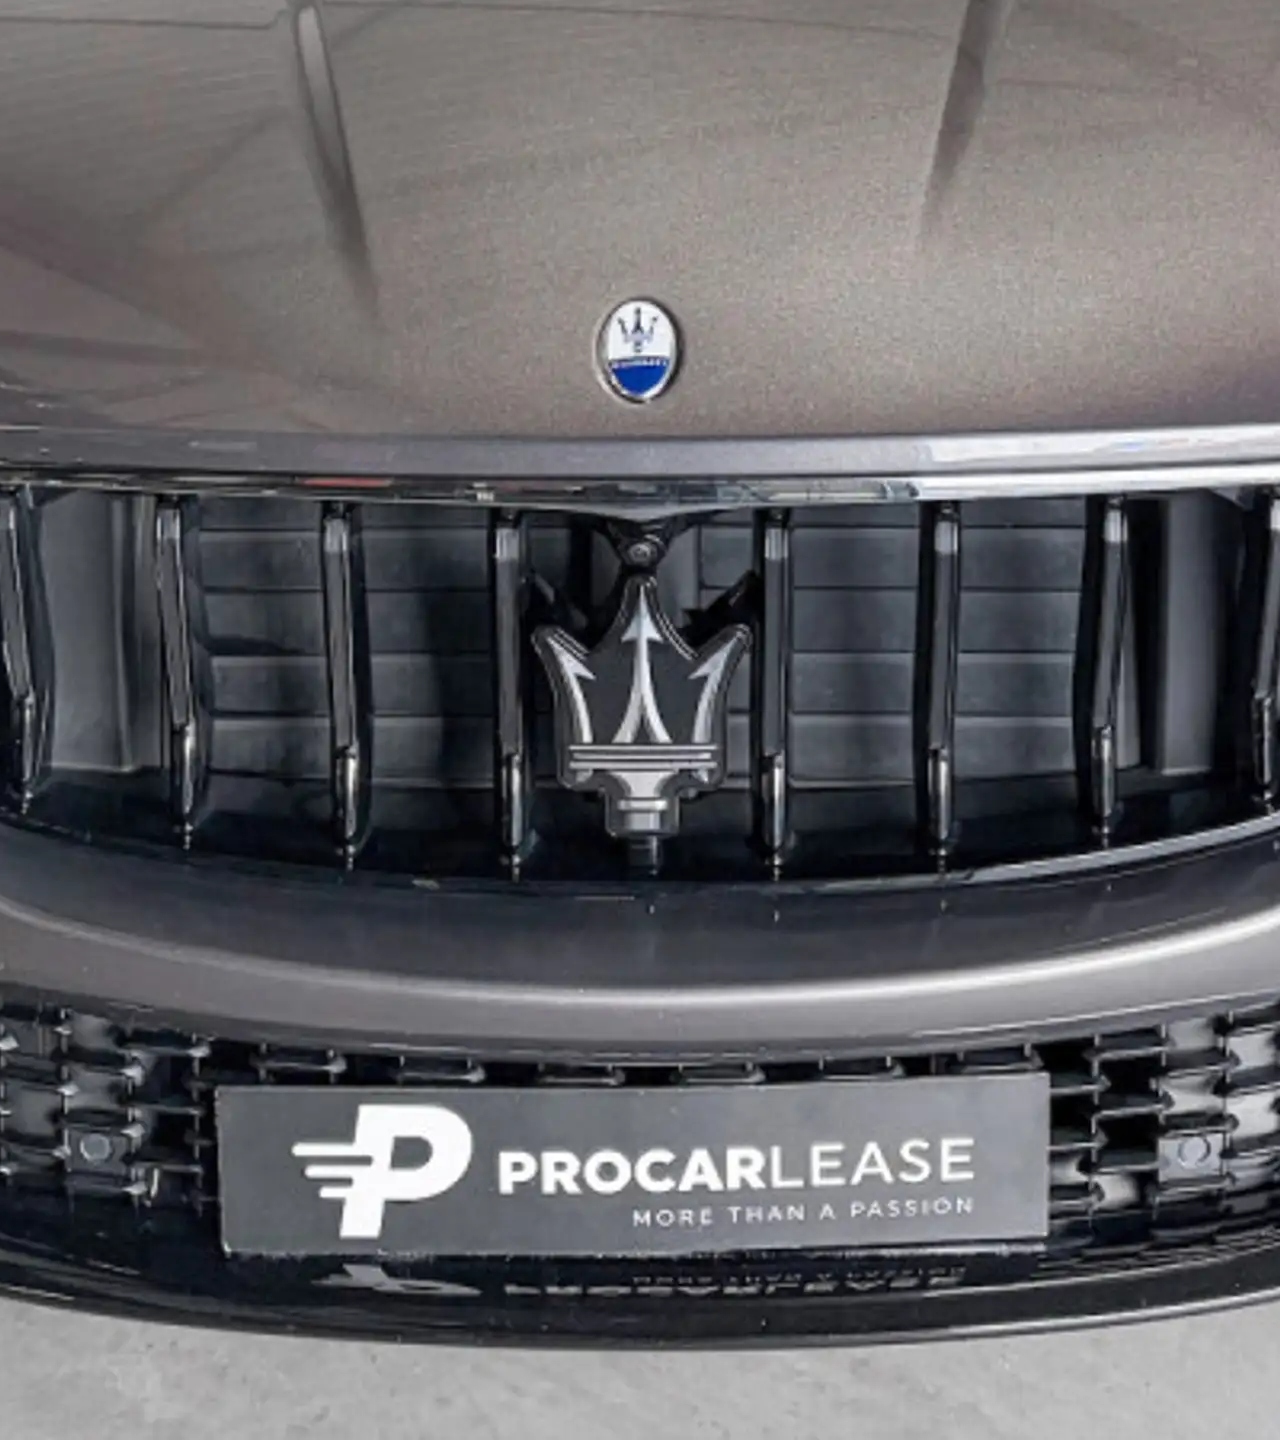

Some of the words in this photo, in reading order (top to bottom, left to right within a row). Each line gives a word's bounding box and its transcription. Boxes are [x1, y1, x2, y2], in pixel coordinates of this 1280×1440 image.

[498, 1133, 977, 1195] PROCARLEASE
[632, 1207, 714, 1228] MORE
[727, 1204, 806, 1224] THAN
[819, 1202, 837, 1221] A
[849, 1195, 976, 1219] PASSION
